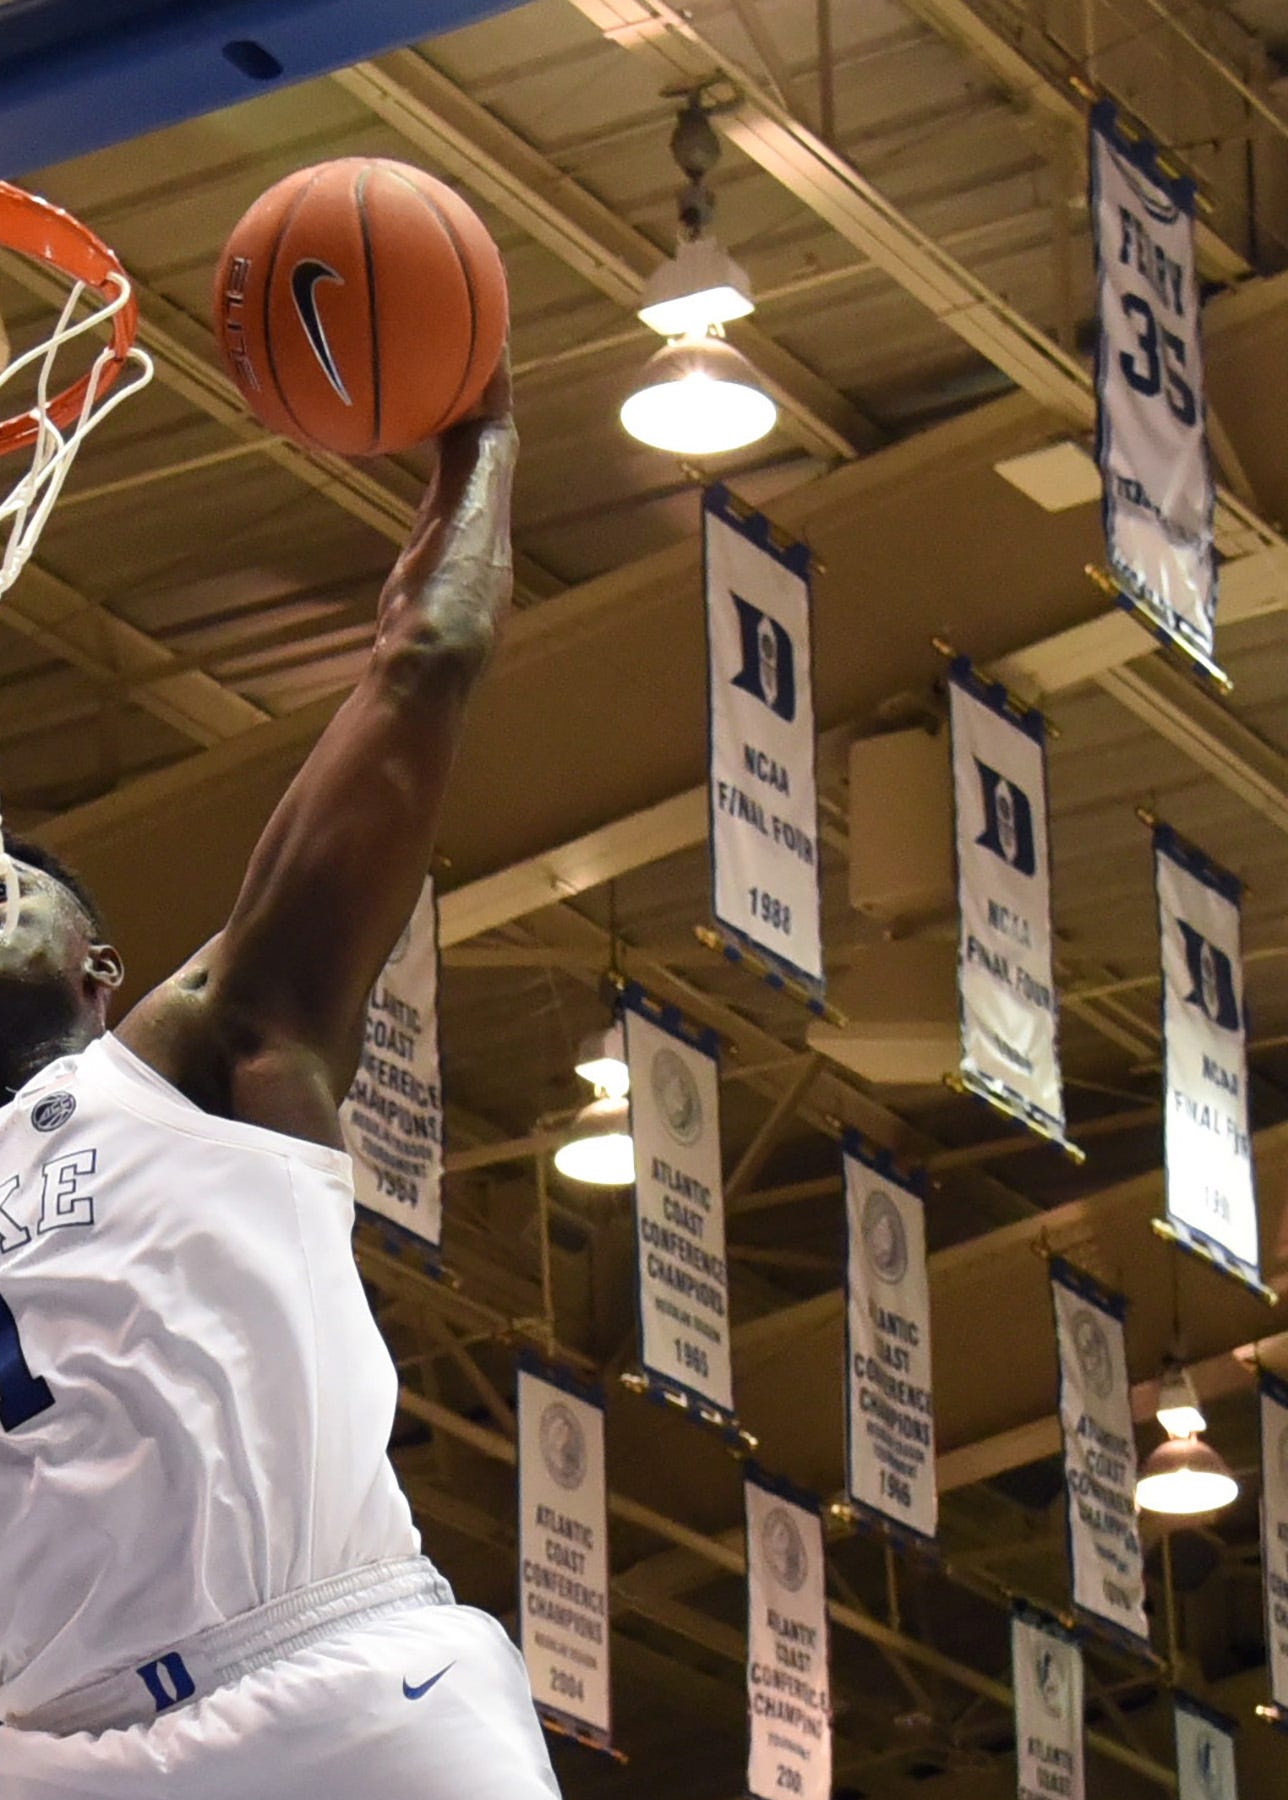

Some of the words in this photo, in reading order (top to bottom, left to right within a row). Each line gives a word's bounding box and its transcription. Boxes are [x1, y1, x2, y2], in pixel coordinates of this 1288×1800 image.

[744, 743, 790, 795] NCAA
[717, 781, 768, 835] FINAL
[772, 816, 814, 866] FOUR
[652, 1156, 711, 1213] ATLANTIC
[663, 1196, 704, 1239] COAST
[641, 1216, 727, 1287] CONFERENCE
[647, 1252, 724, 1318] CHAMPIONS
[535, 1504, 593, 1550] ATLANTIC
[546, 1539, 585, 1575] COAST
[523, 1560, 605, 1616] CONFERENCE
[527, 1592, 603, 1645] CHAMPIONS
[136, 1651, 195, 1712] D
